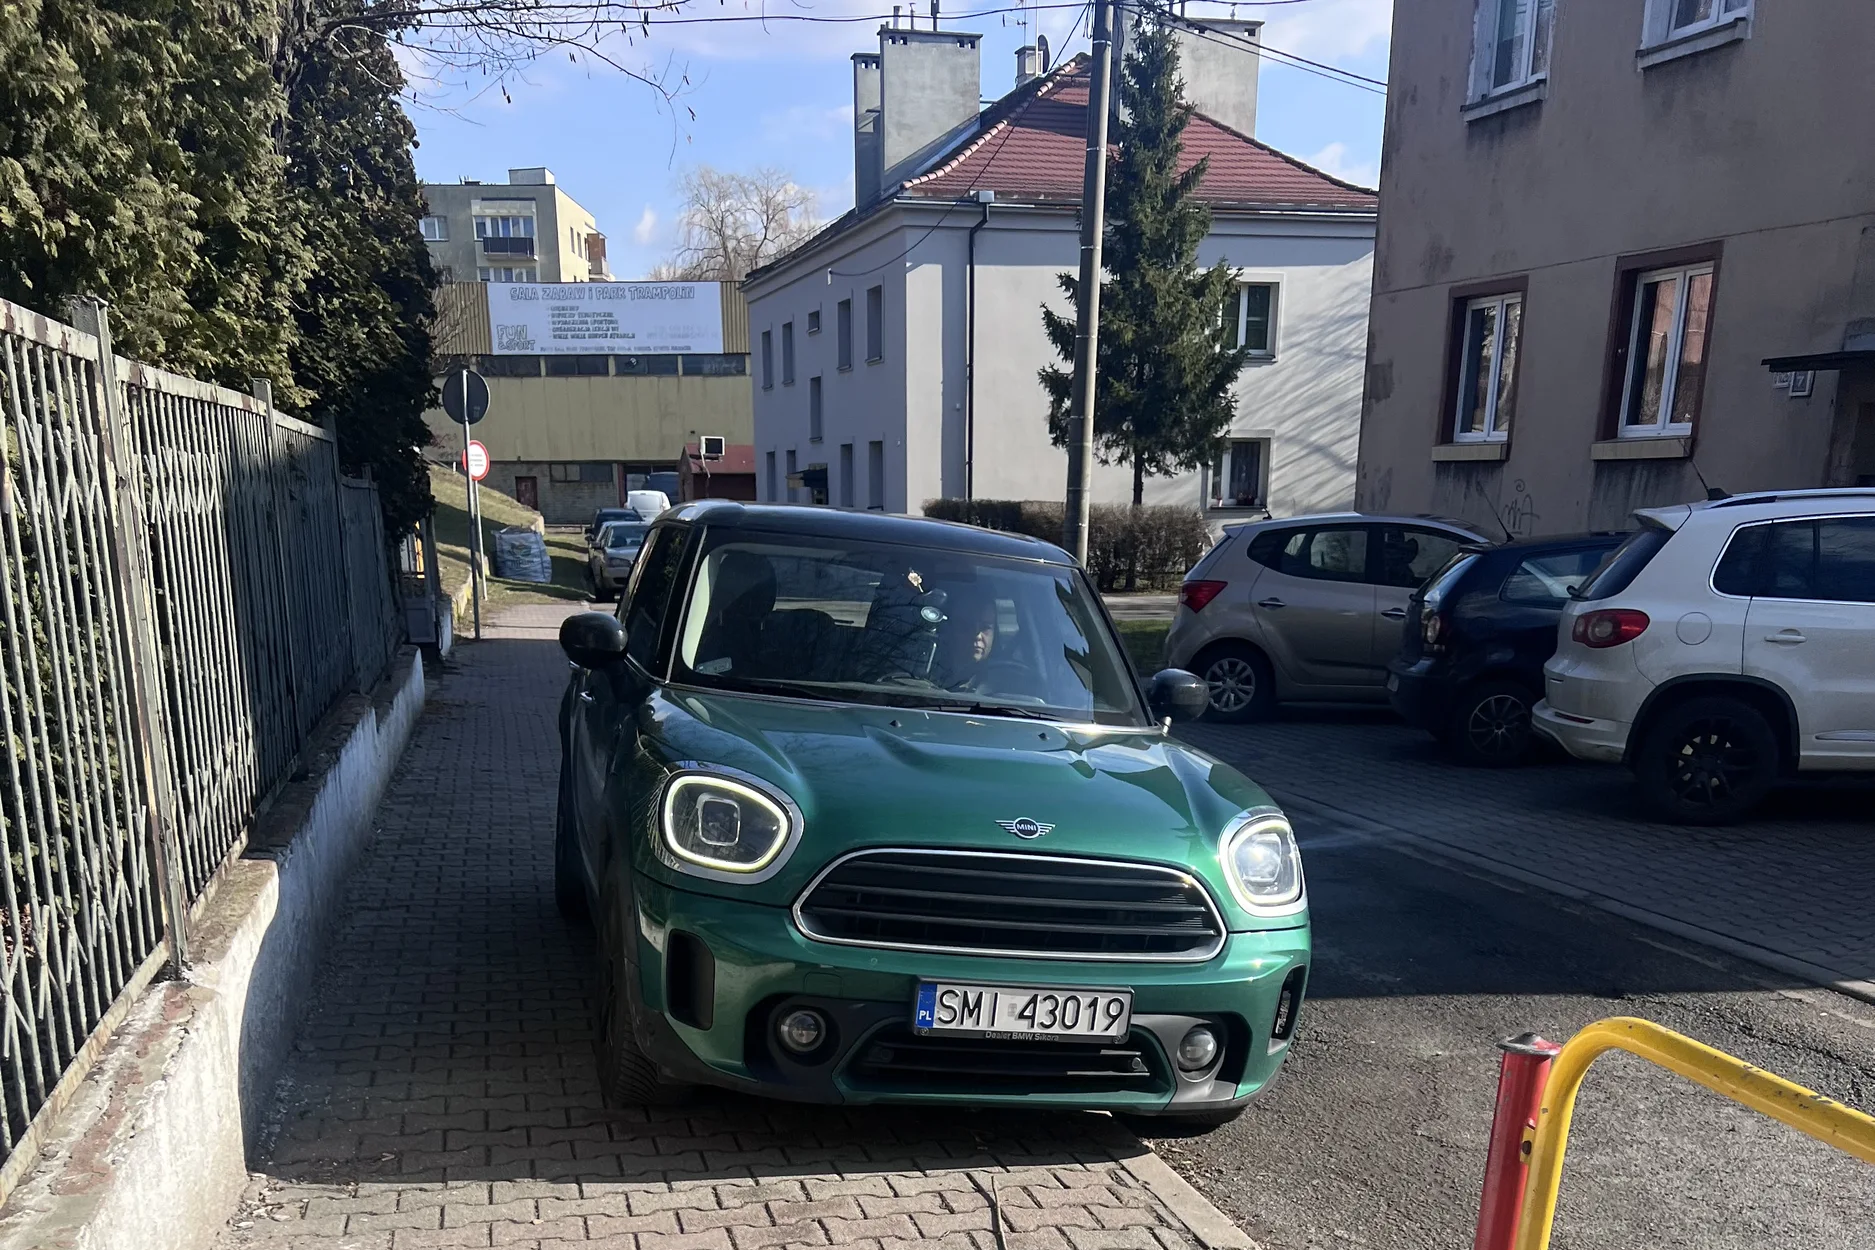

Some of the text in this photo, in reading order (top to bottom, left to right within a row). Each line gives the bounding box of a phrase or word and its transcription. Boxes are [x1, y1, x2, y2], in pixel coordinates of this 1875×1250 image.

[509, 286, 540, 301] SALA
[542, 286, 586, 301] ZABAW
[595, 285, 627, 300] PARK
[496, 324, 528, 341] FUN
[1797, 376, 1805, 387] 7
[918, 1010, 932, 1021] PL
[938, 990, 1125, 1032] SMI 43019
[1012, 1032, 1034, 1041] BMW
[1034, 1033, 1059, 1041] Sikora
